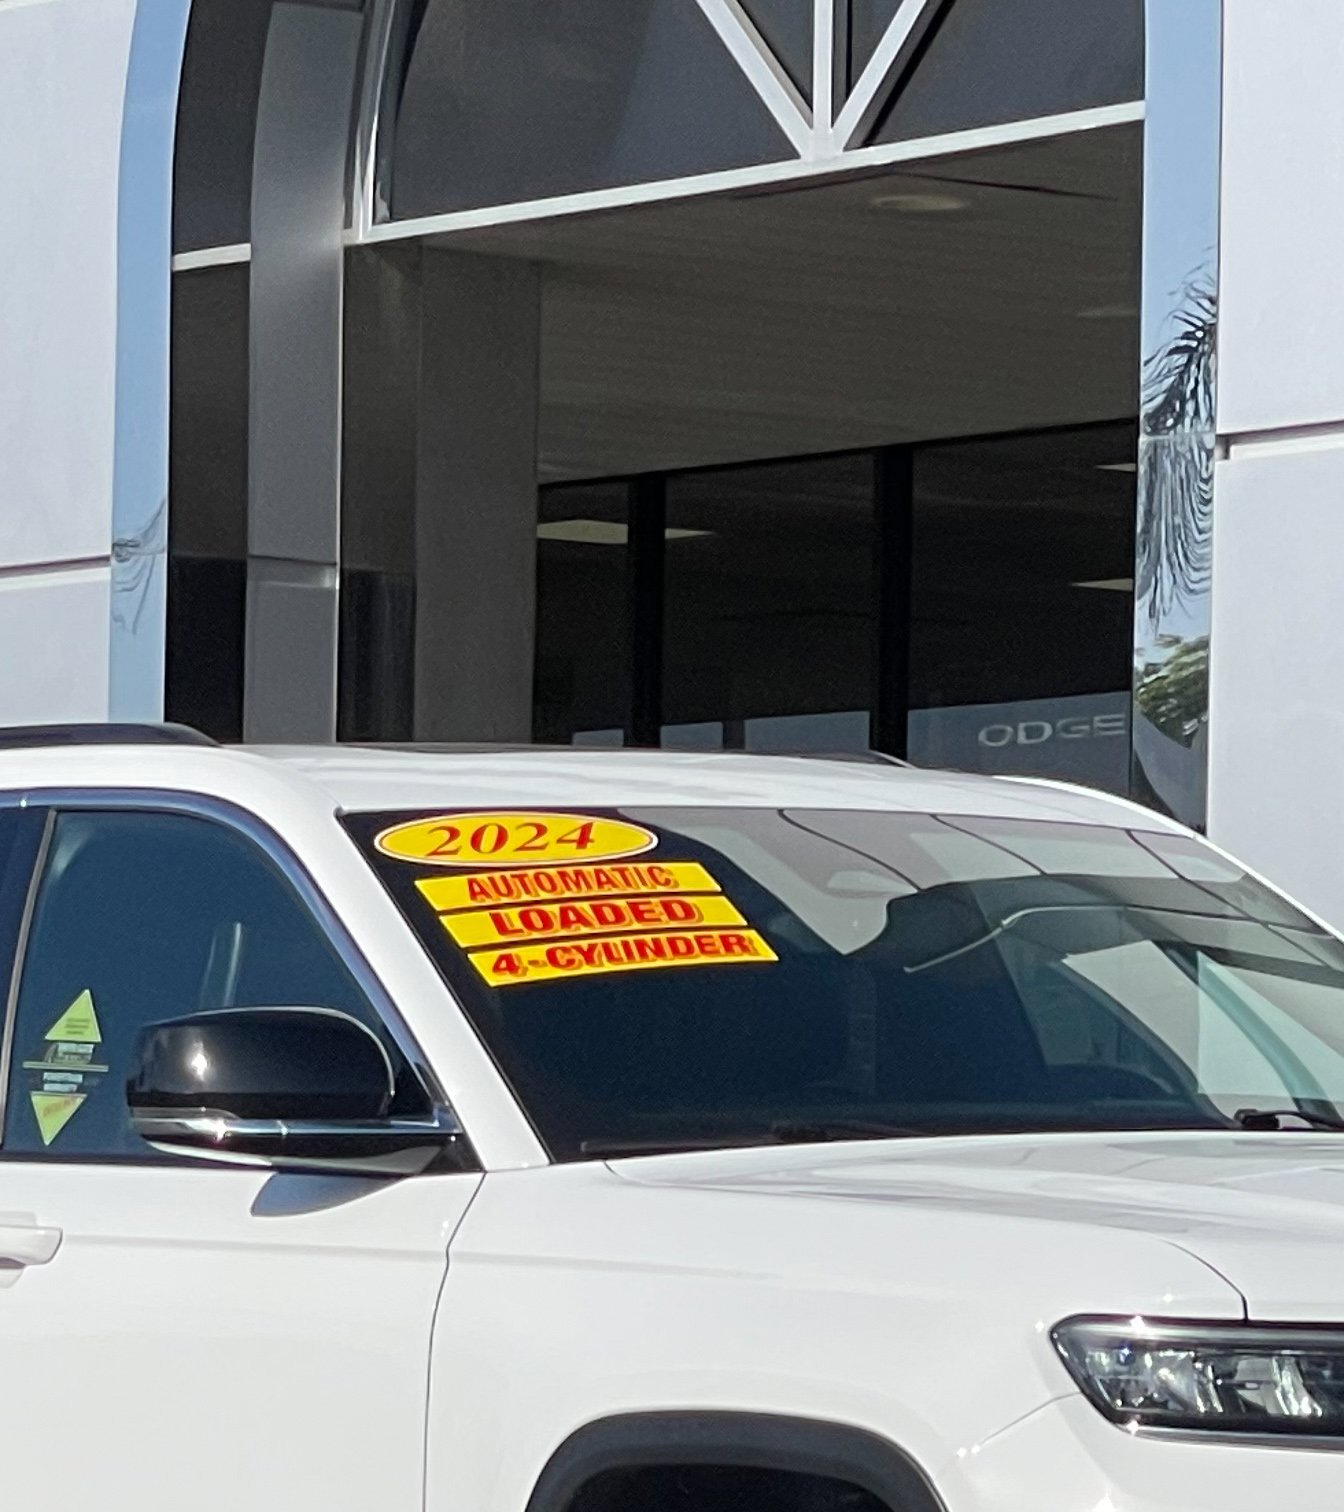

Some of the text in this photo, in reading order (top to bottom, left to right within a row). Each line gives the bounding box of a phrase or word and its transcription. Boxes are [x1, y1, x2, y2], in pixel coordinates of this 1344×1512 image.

[425, 821, 595, 857] 2024
[467, 866, 678, 903] AUTOMATIC
[490, 897, 701, 937] LOADED
[492, 934, 754, 977] 4-CYLINDER
